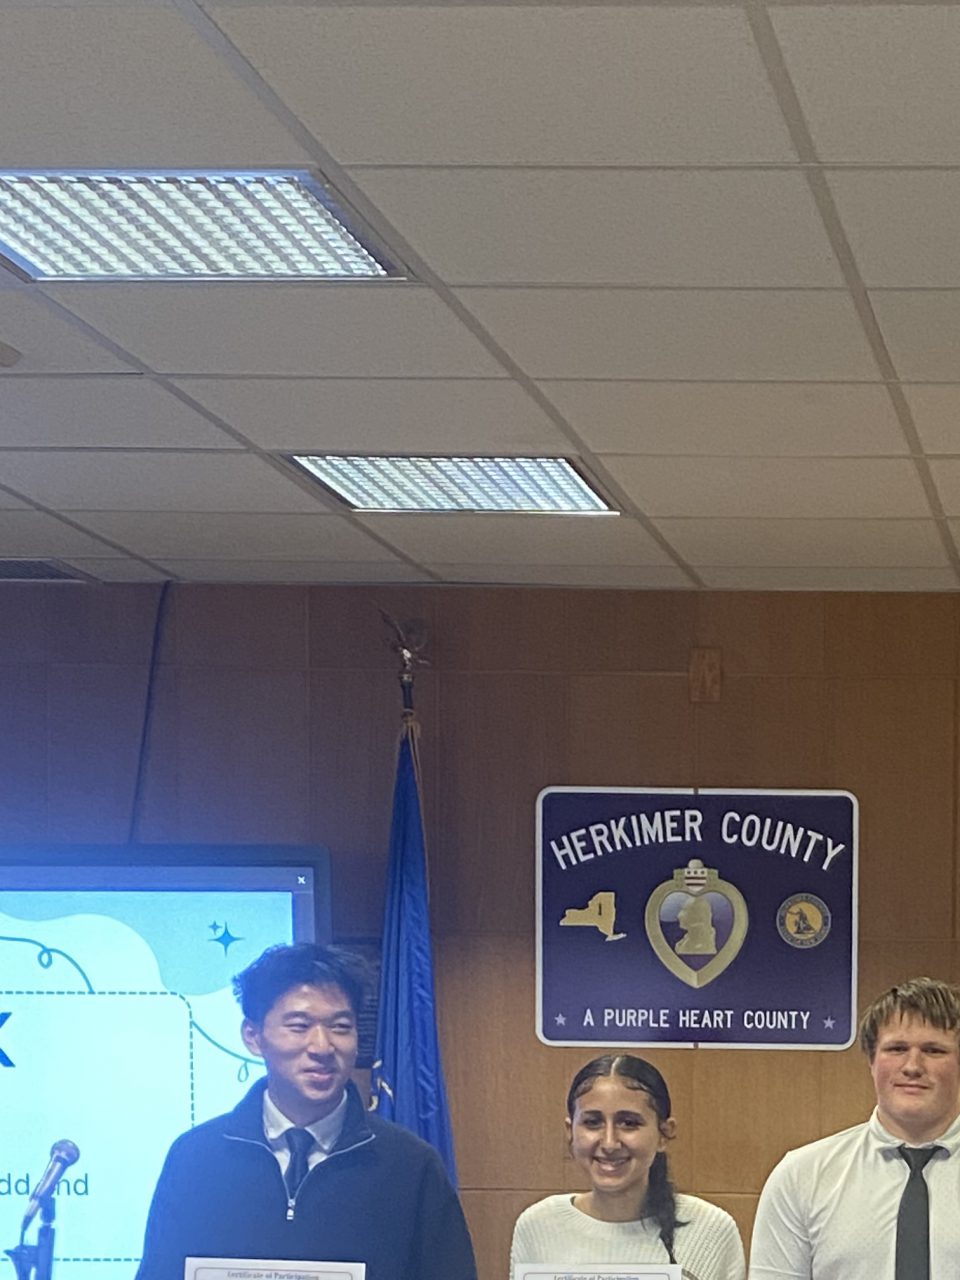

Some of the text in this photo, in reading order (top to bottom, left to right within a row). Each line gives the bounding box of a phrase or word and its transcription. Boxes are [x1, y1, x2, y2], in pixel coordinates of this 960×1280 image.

[550, 809, 846, 871] HERKIMER COUNTY
[583, 1009, 810, 1030] A PURPLE HEART COUNTY
[228, 1272, 264, 1280] Certificate
